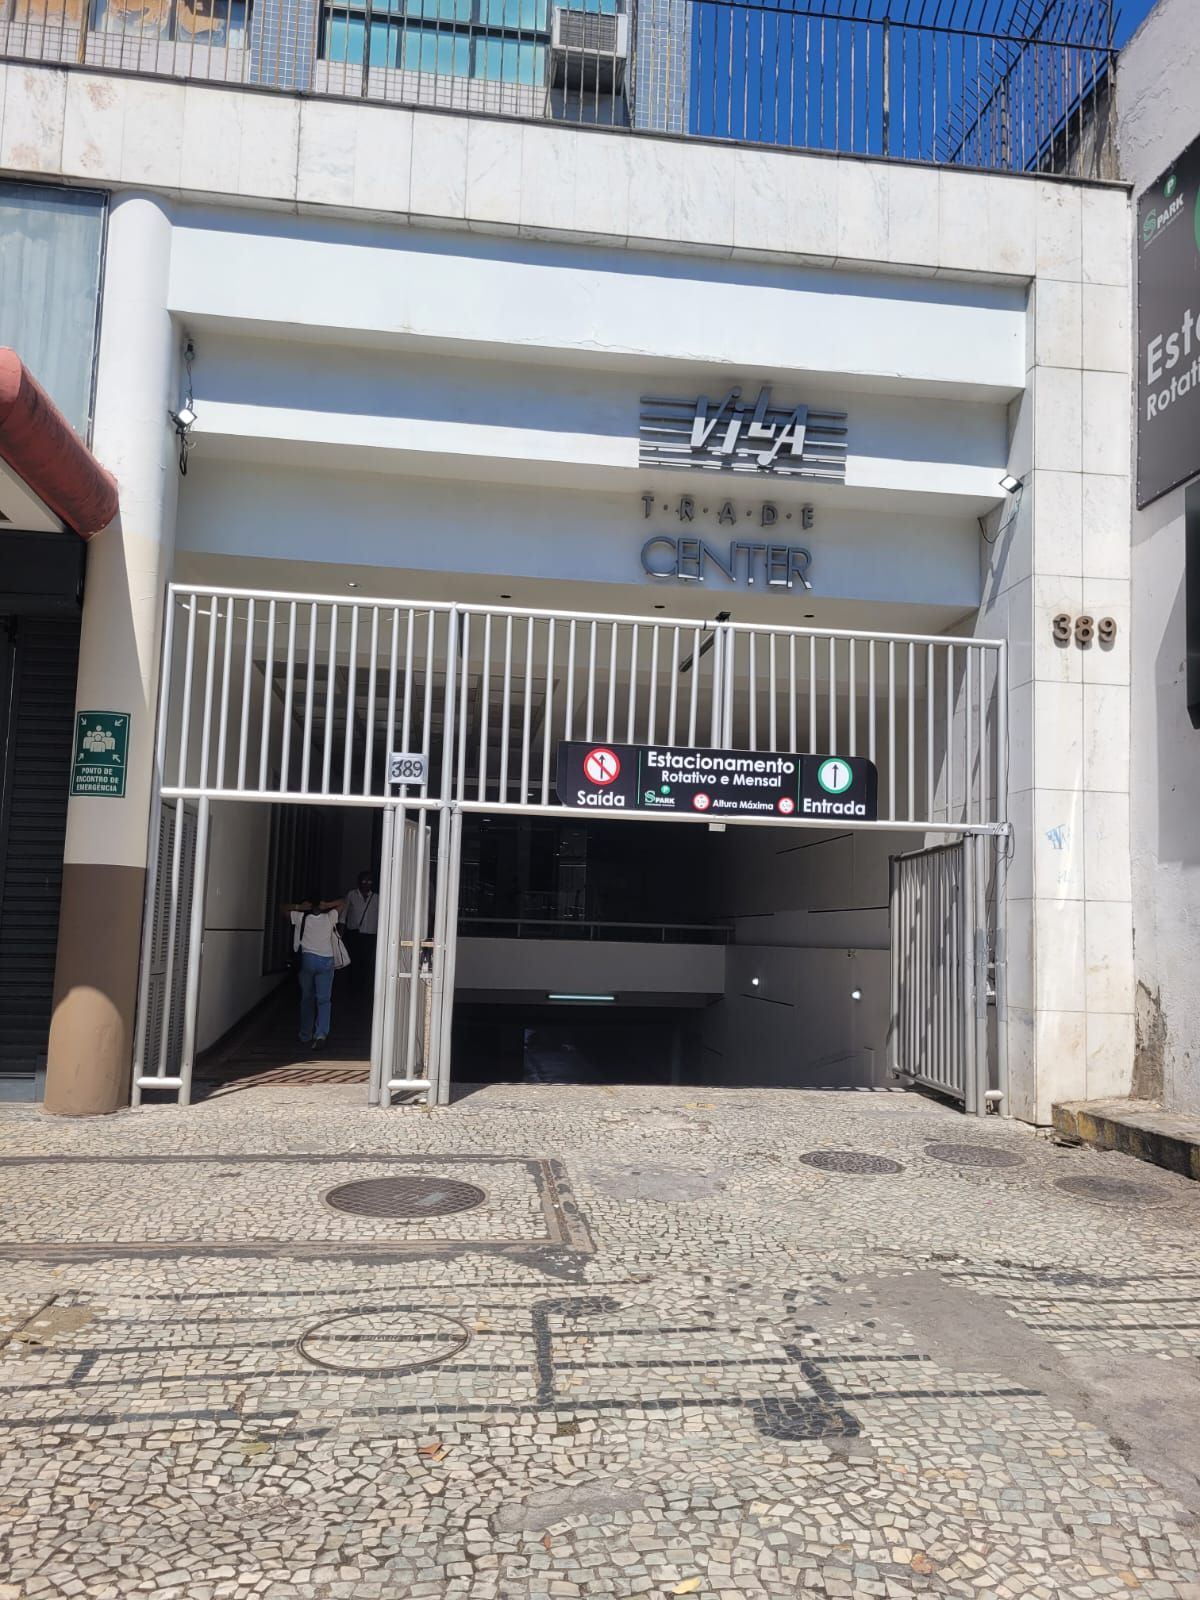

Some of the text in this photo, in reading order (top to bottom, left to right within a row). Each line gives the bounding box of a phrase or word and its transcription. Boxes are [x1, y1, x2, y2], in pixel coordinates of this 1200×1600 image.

[640, 535, 813, 590] CENTER
[1052, 613, 1117, 643] 389
[81, 767, 102, 775] PONTO
[391, 759, 424, 778] 389
[647, 751, 795, 774] Estacionamento
[76, 775, 109, 783] ENCONTRO
[661, 770, 782, 788] Rotativo e Mensal
[577, 789, 625, 807] Saída
[739, 800, 774, 811] Máxima
[803, 798, 866, 815] Entrada
